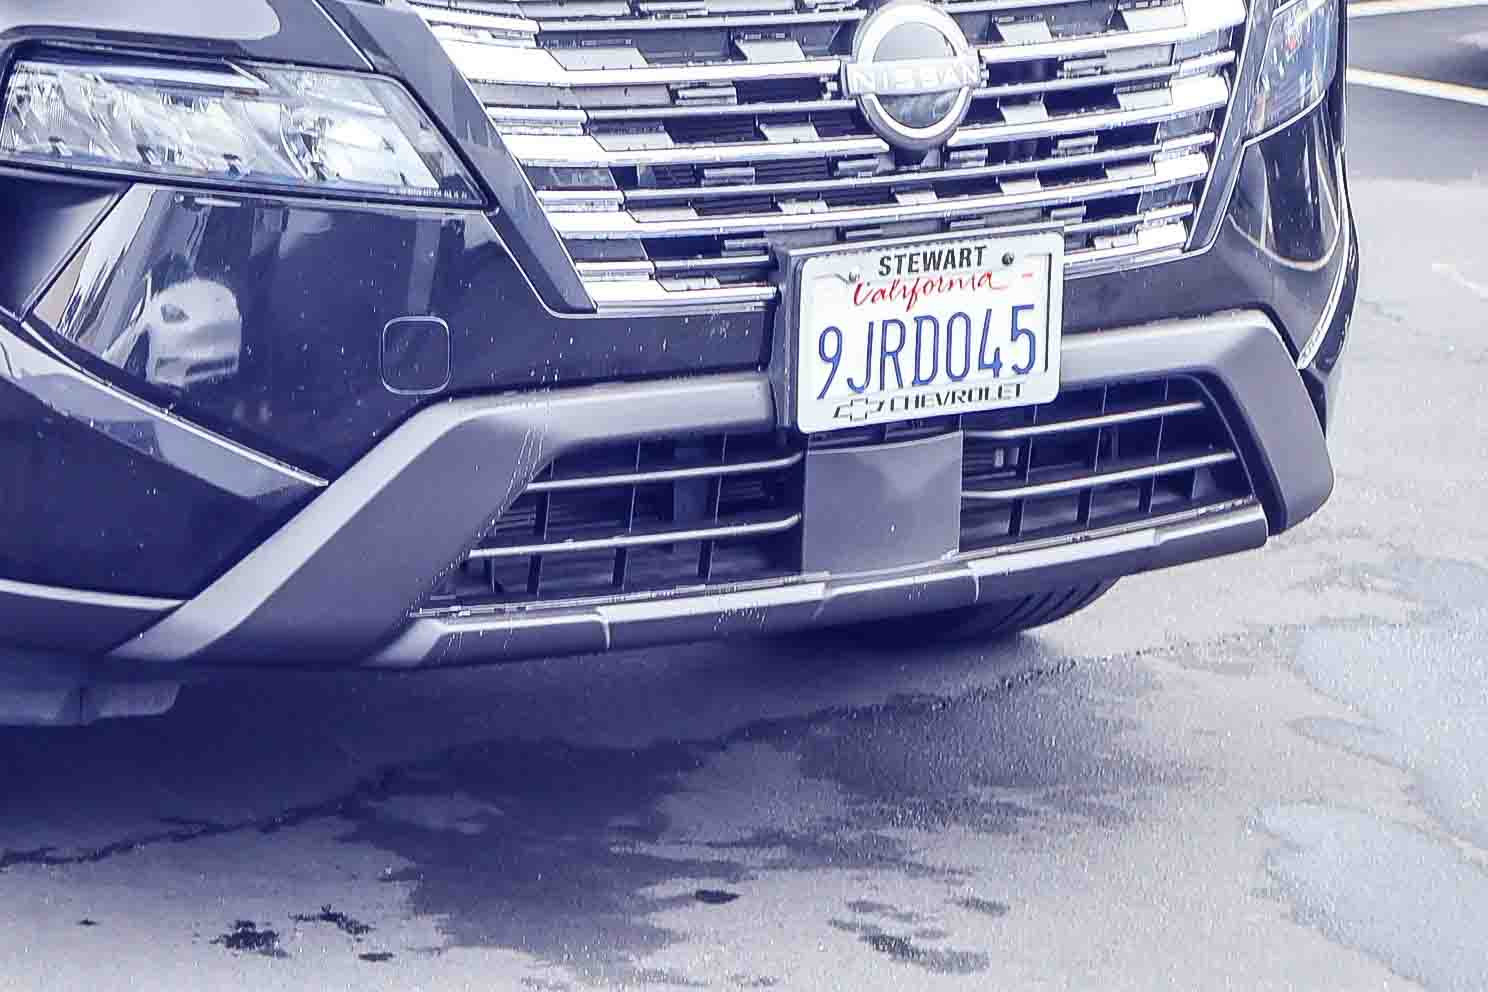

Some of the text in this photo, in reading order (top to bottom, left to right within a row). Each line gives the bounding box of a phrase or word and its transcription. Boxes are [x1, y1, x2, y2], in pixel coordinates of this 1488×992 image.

[878, 245, 987, 276] STEWART
[853, 271, 1007, 312] California
[816, 304, 1037, 401] 9JRD045
[889, 383, 1022, 413] CHEVROLET
